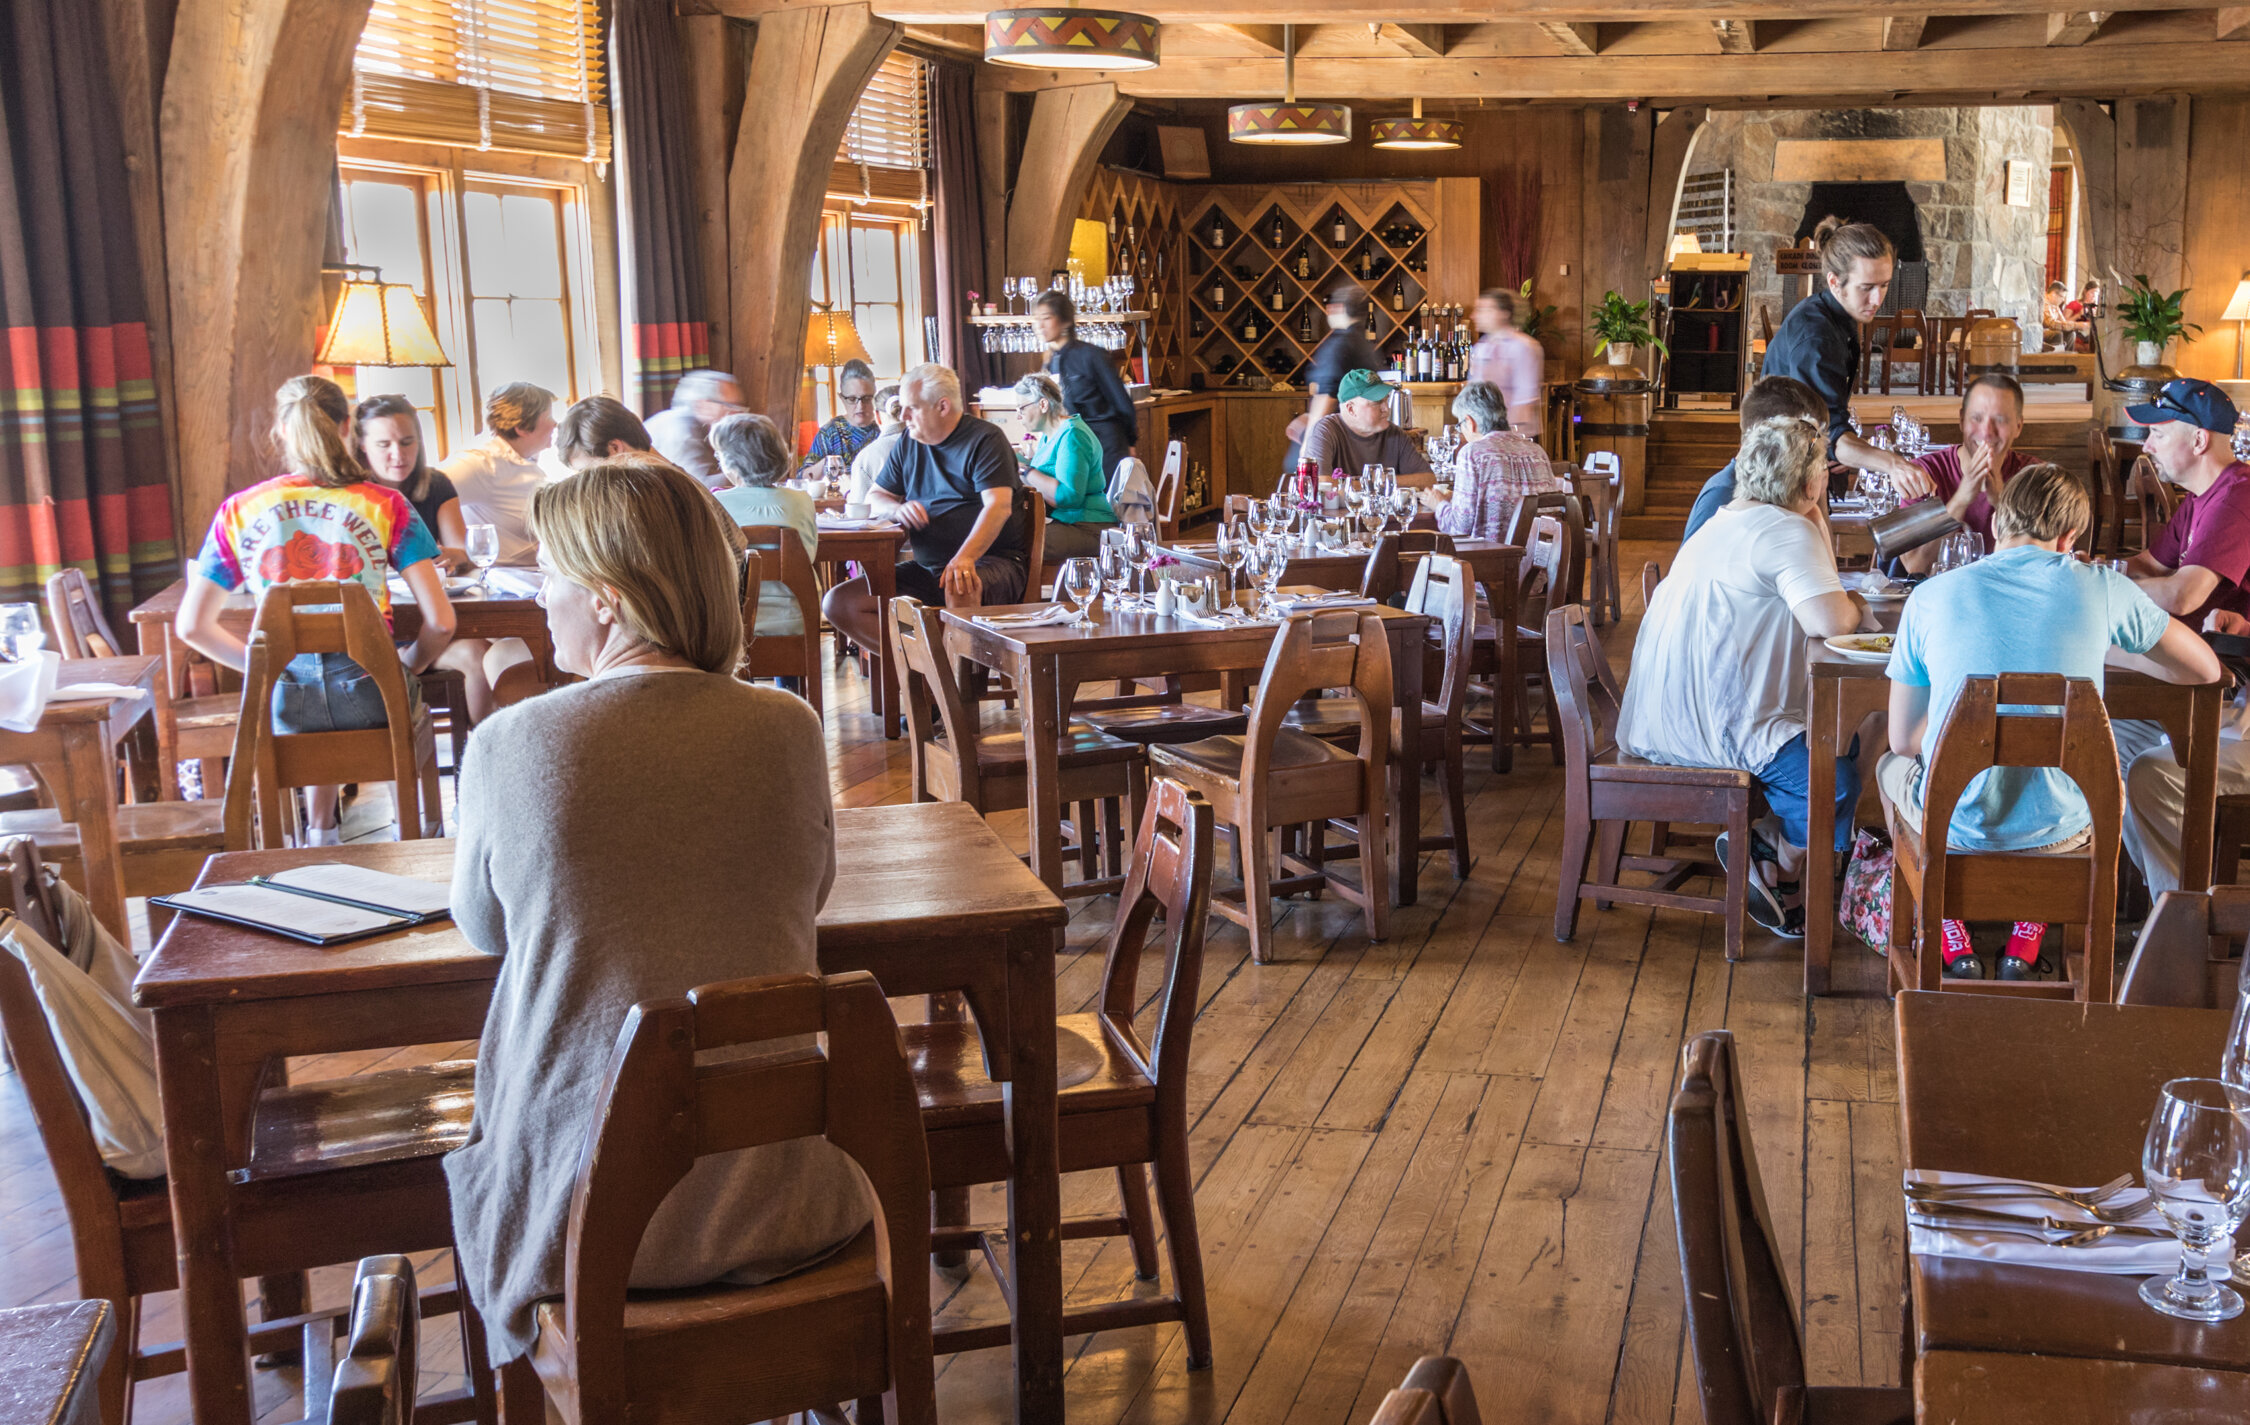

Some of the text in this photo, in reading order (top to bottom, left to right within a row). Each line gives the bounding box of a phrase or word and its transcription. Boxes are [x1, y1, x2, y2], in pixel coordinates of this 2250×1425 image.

[240, 499, 387, 580] ARE THEE WELL
